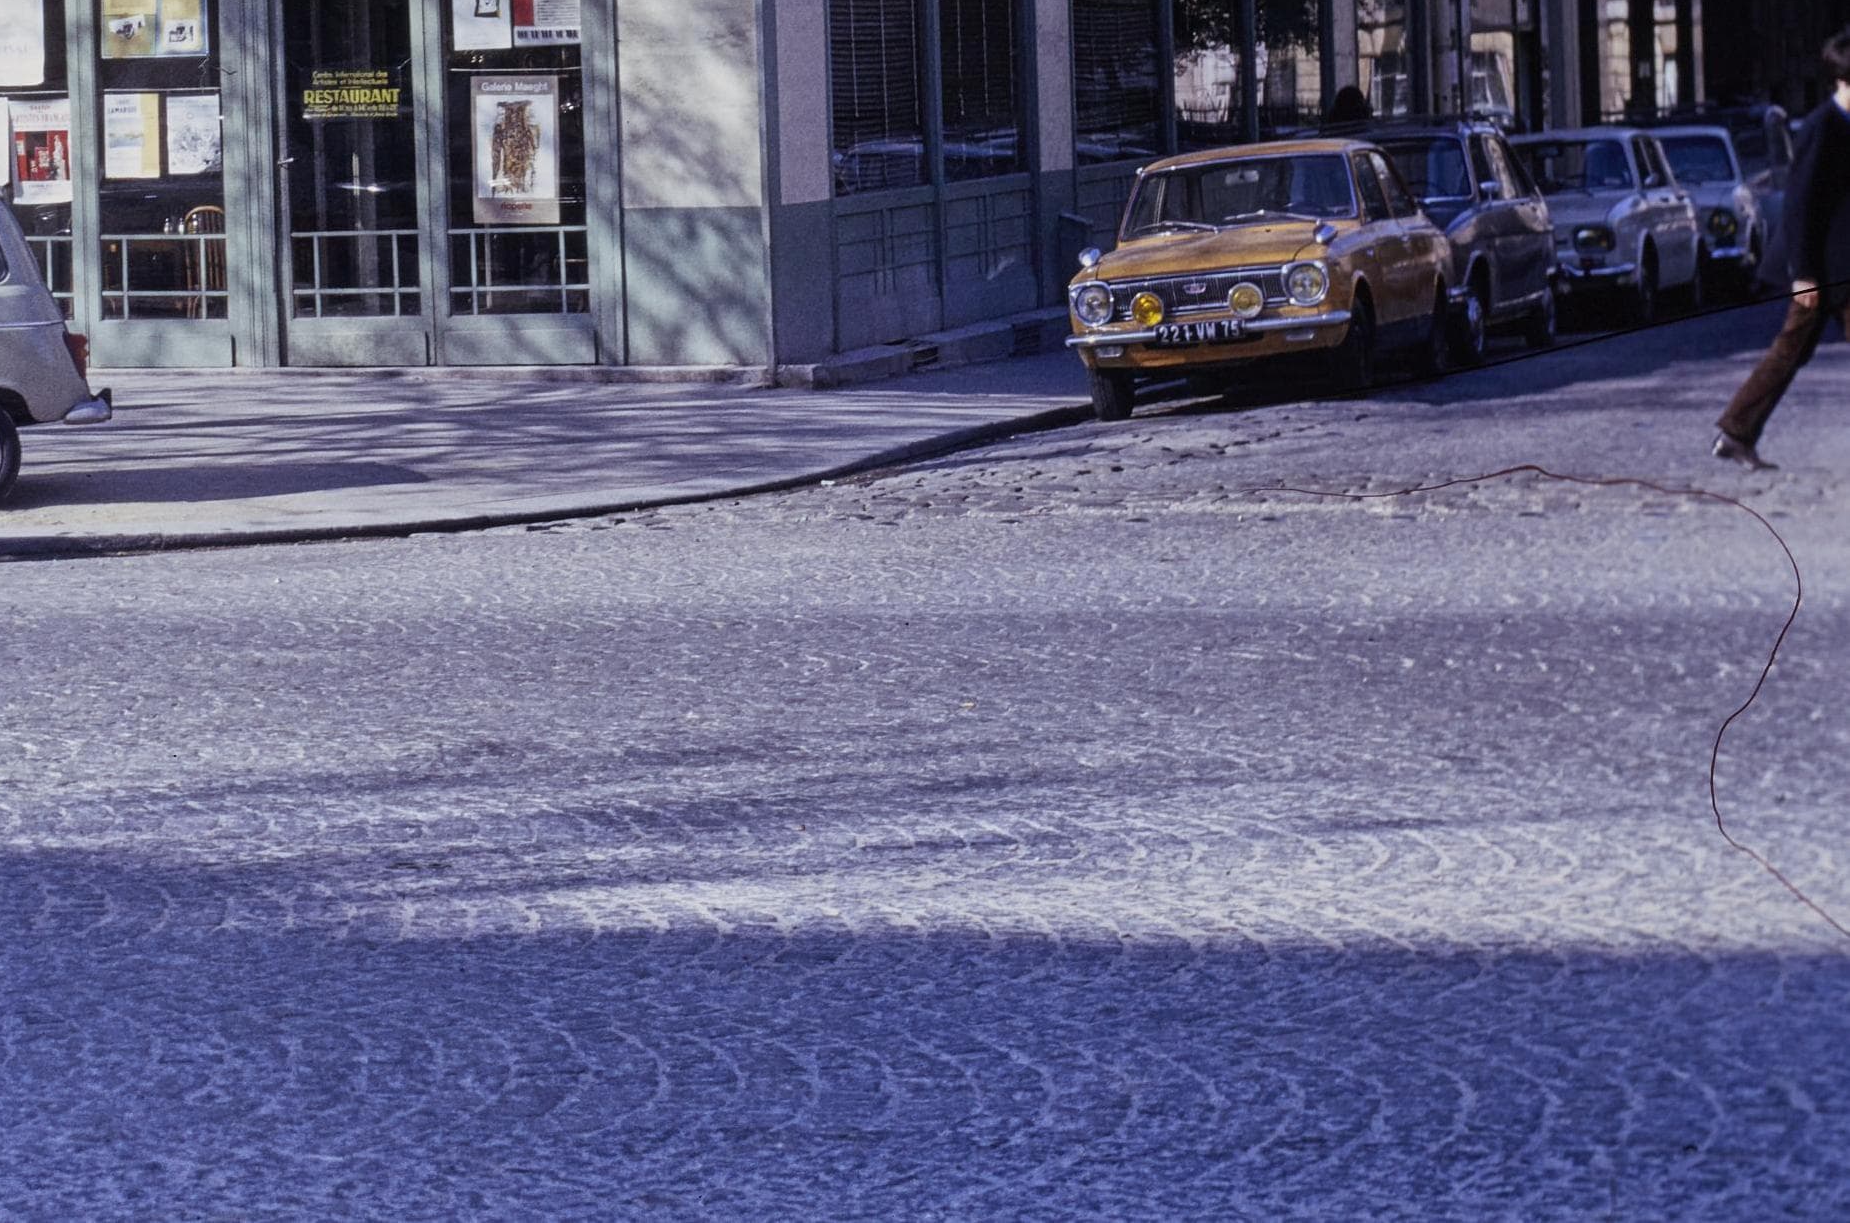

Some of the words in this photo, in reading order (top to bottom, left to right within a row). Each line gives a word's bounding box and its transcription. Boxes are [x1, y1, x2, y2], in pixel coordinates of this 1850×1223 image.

[303, 88, 401, 104] RESTAURANT
[1159, 325, 1190, 343] 221
[1195, 322, 1216, 340] VW
[1221, 320, 1239, 337] 75
